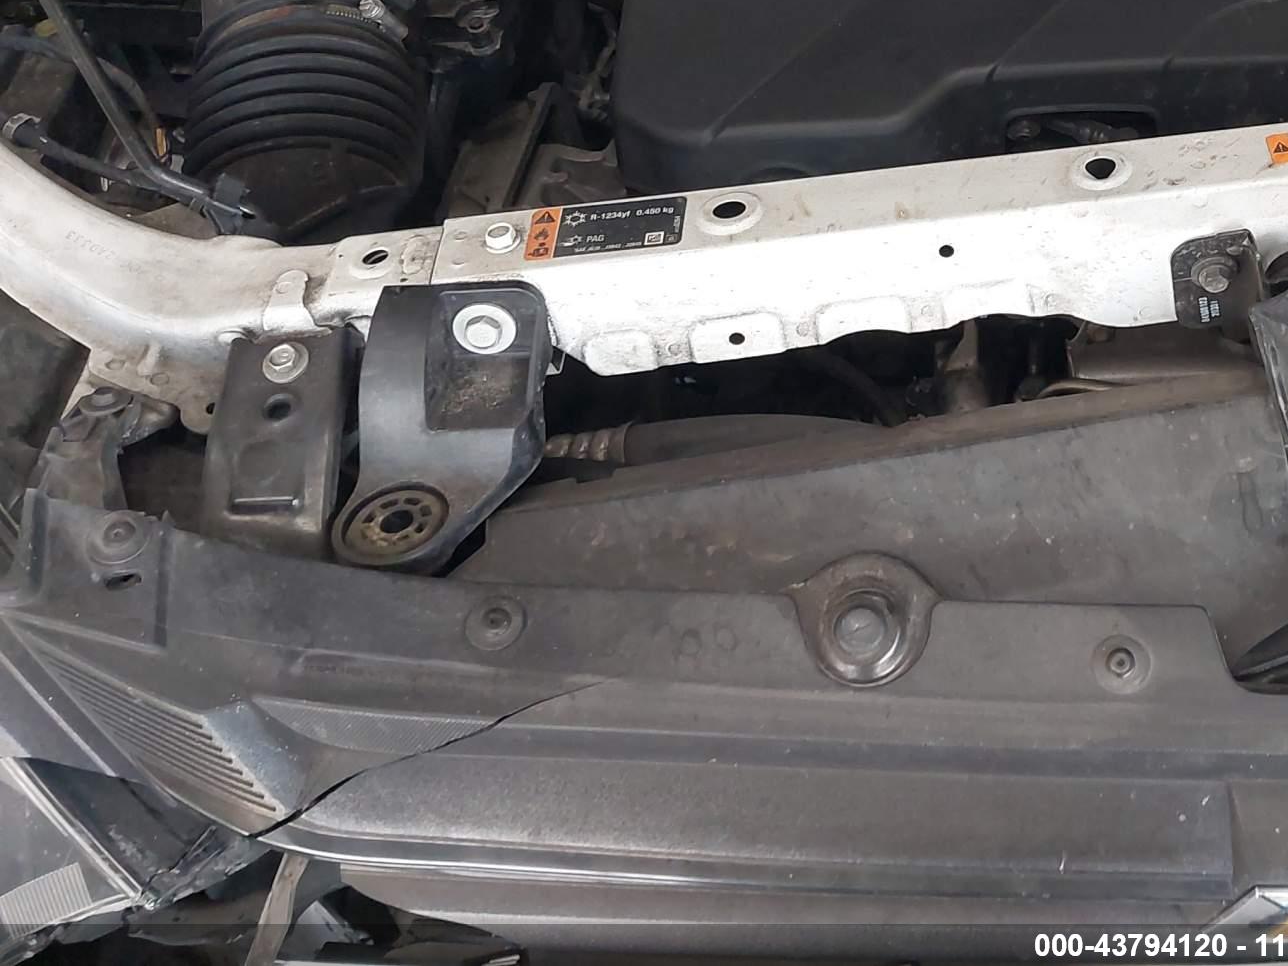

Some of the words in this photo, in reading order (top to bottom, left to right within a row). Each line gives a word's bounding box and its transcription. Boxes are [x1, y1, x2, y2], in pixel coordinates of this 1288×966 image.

[590, 210, 630, 221] R-1234yf
[663, 206, 674, 214] kg
[586, 234, 605, 243] PAG
